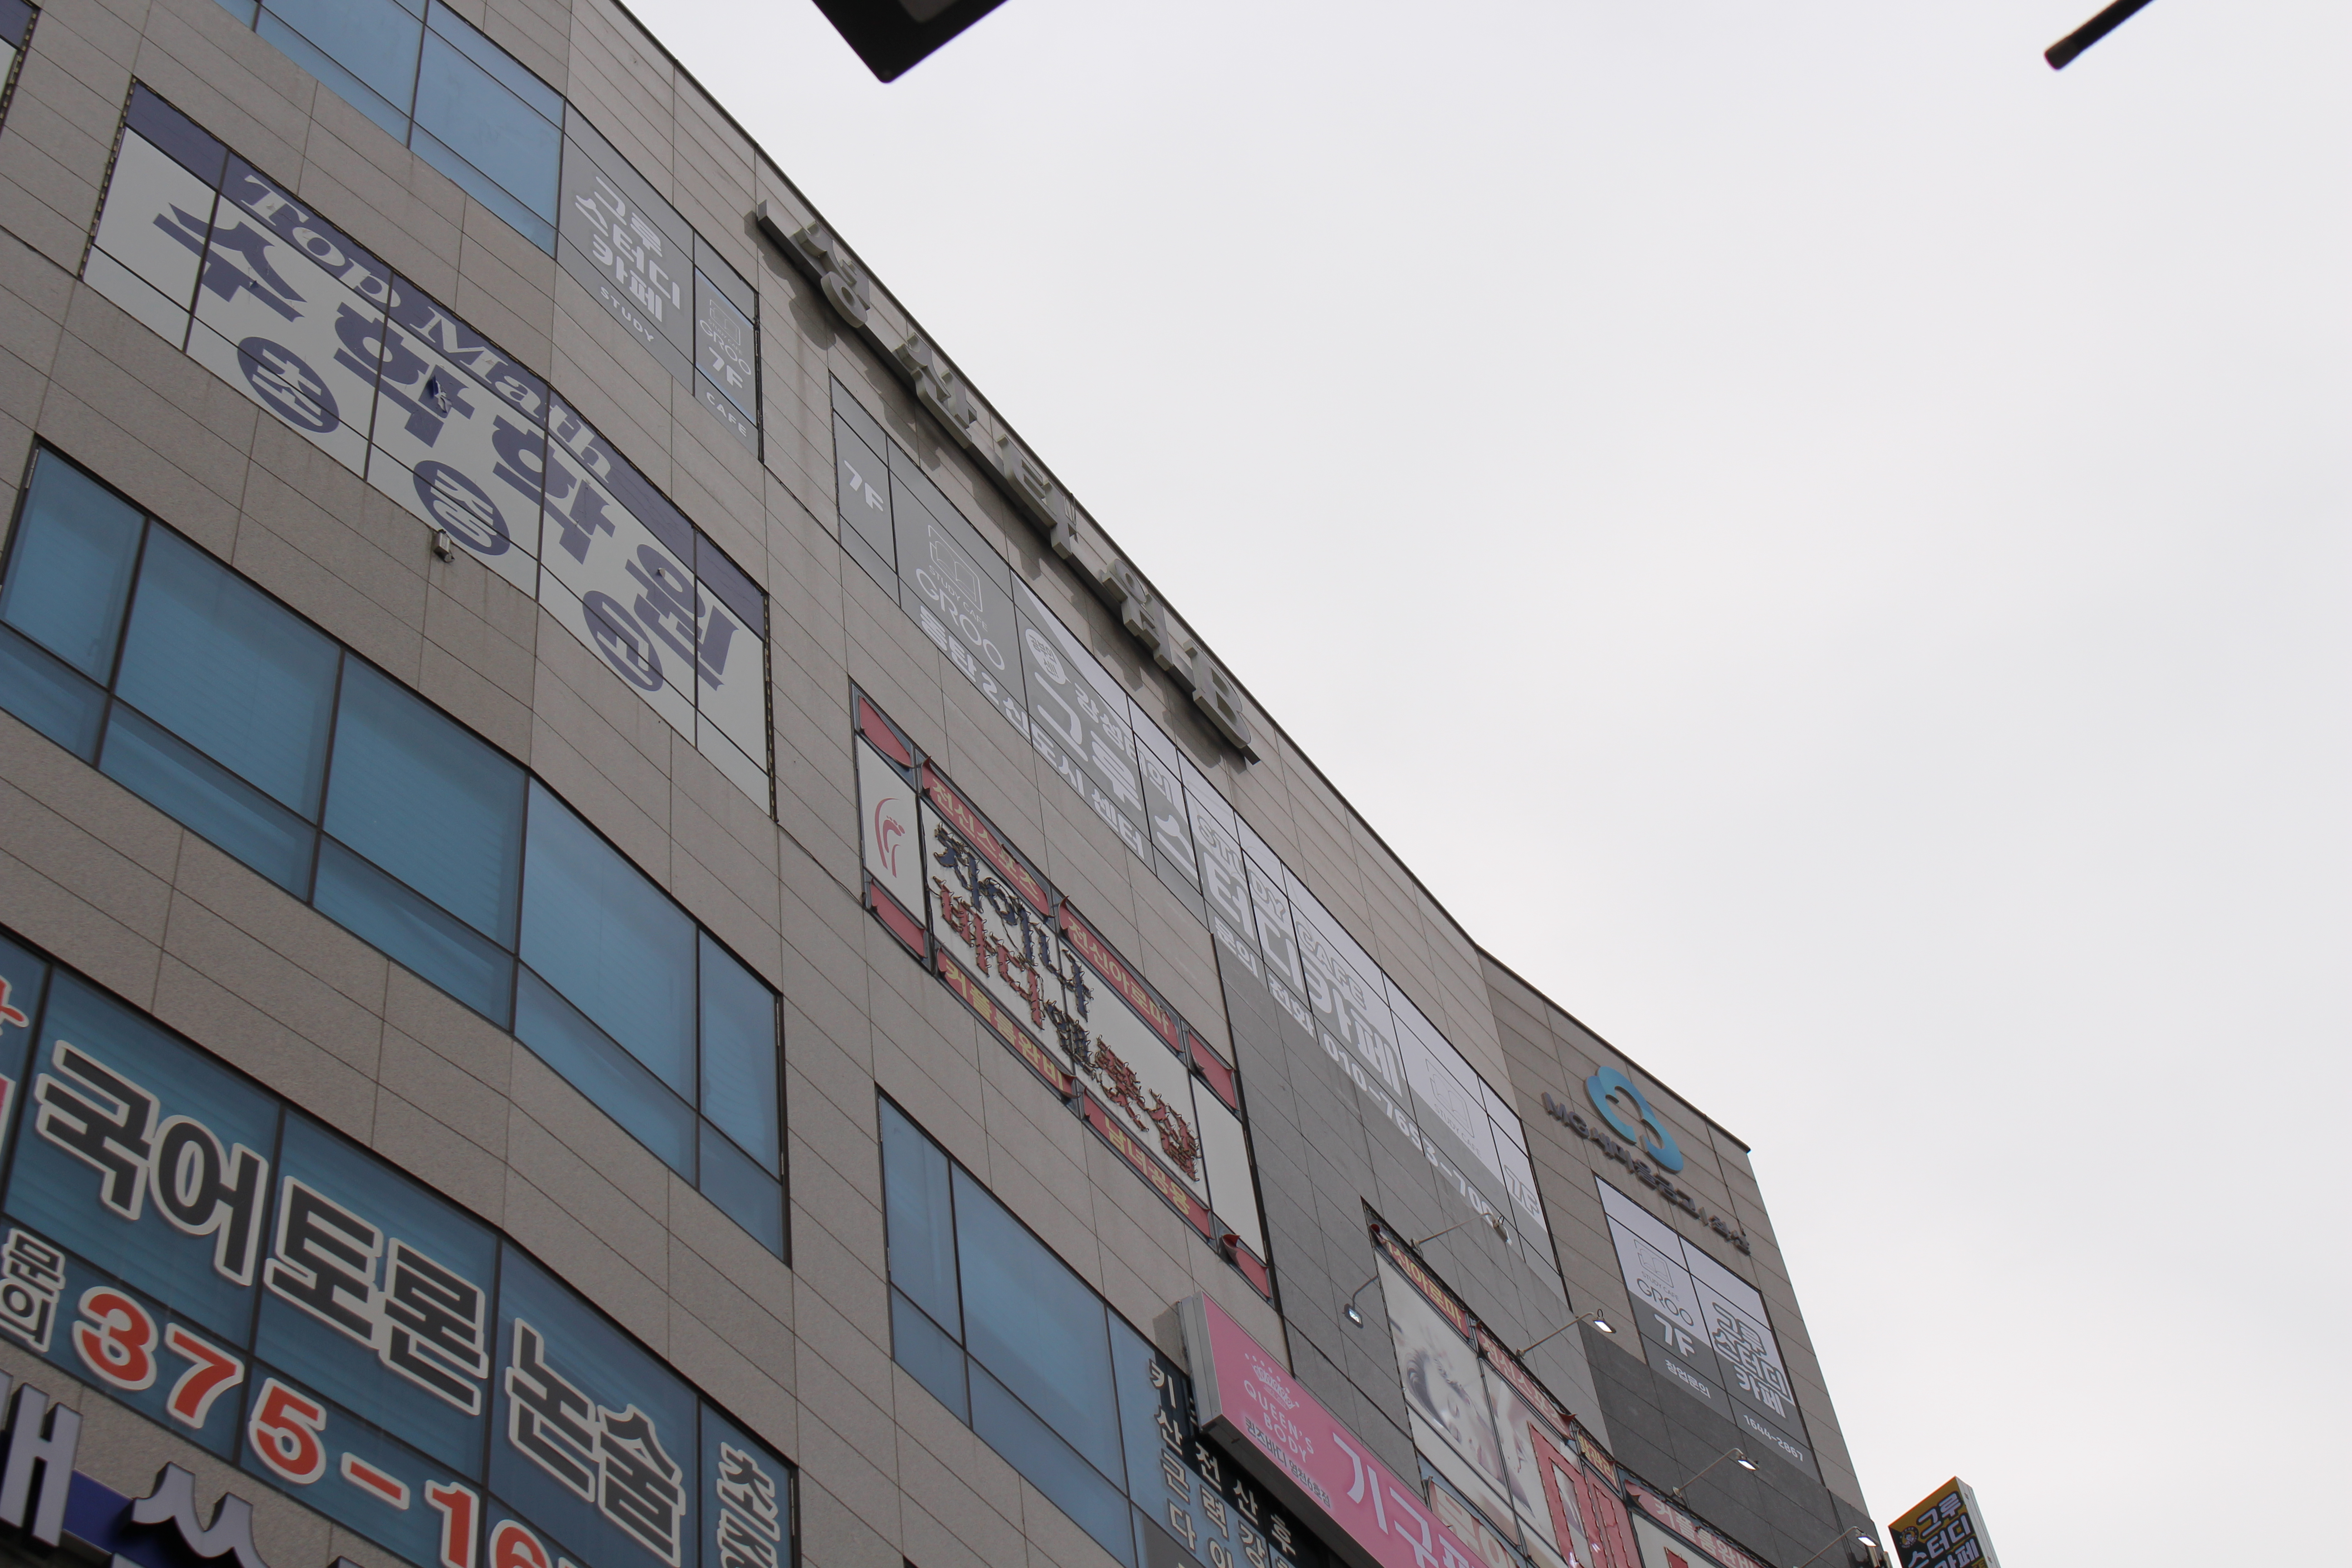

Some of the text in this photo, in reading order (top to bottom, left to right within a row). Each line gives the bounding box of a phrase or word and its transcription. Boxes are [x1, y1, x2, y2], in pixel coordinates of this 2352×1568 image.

[575, 195, 680, 309] 스터디
[596, 176, 662, 257] 그루
[593, 234, 662, 322] 카페
[240, 175, 612, 484] Top Math
[600, 286, 746, 437] STUDY CAFE
[700, 320, 751, 375] GROO
[708, 347, 743, 388] 7F
[251, 346, 323, 427] 초
[152, 202, 740, 691] 수학학원
[844, 460, 884, 512] 7F
[431, 469, 494, 550] 중
[596, 601, 650, 672] 고
[916, 568, 1004, 670] GROO
[930, 566, 988, 632] STUDY CAFE
[921, 605, 1145, 860] 동탄2신도시 센터
[1075, 683, 1175, 804] 강성태의
[933, 778, 1040, 902] 전신스포츠
[934, 822, 1092, 1022] 차이나
[1034, 672, 1403, 1098] 그루 스터디카페
[1196, 815, 1367, 1011] STUDY CAFE
[1068, 917, 1170, 1036] 전신아로마
[946, 959, 1063, 1091] 커플룸완비
[1215, 916, 1509, 1241] 문의 전화 010-7653-700
[1104, 1115, 1190, 1215] 남녀공용
[1434, 1104, 1482, 1159] STUDY CAFE
[1541, 1092, 1700, 1220] MG새마을금고
[1504, 1165, 1539, 1217] 7F
[34, 1040, 686, 1568] 국어토론논술
[1637, 1278, 1694, 1327] GROO
[1642, 1271, 1680, 1303] STUDY CAFE
[1654, 1313, 1695, 1357] 7F
[1712, 1301, 1767, 1357] 그루
[1712, 1328, 1794, 1402] 스터디
[1244, 1380, 1314, 1455] QUEEN'S
[1665, 1359, 1712, 1399] 창업문의
[1736, 1368, 1787, 1419] 카페
[72, 1286, 572, 1568] 375-1
[1245, 1416, 1287, 1467] 퀸즈바디
[1263, 1412, 1306, 1463] BODY
[1743, 1414, 1804, 1462] 1644-2867
[1908, 1515, 1971, 1568] 스터디
[1917, 1493, 1961, 1537] 그루
